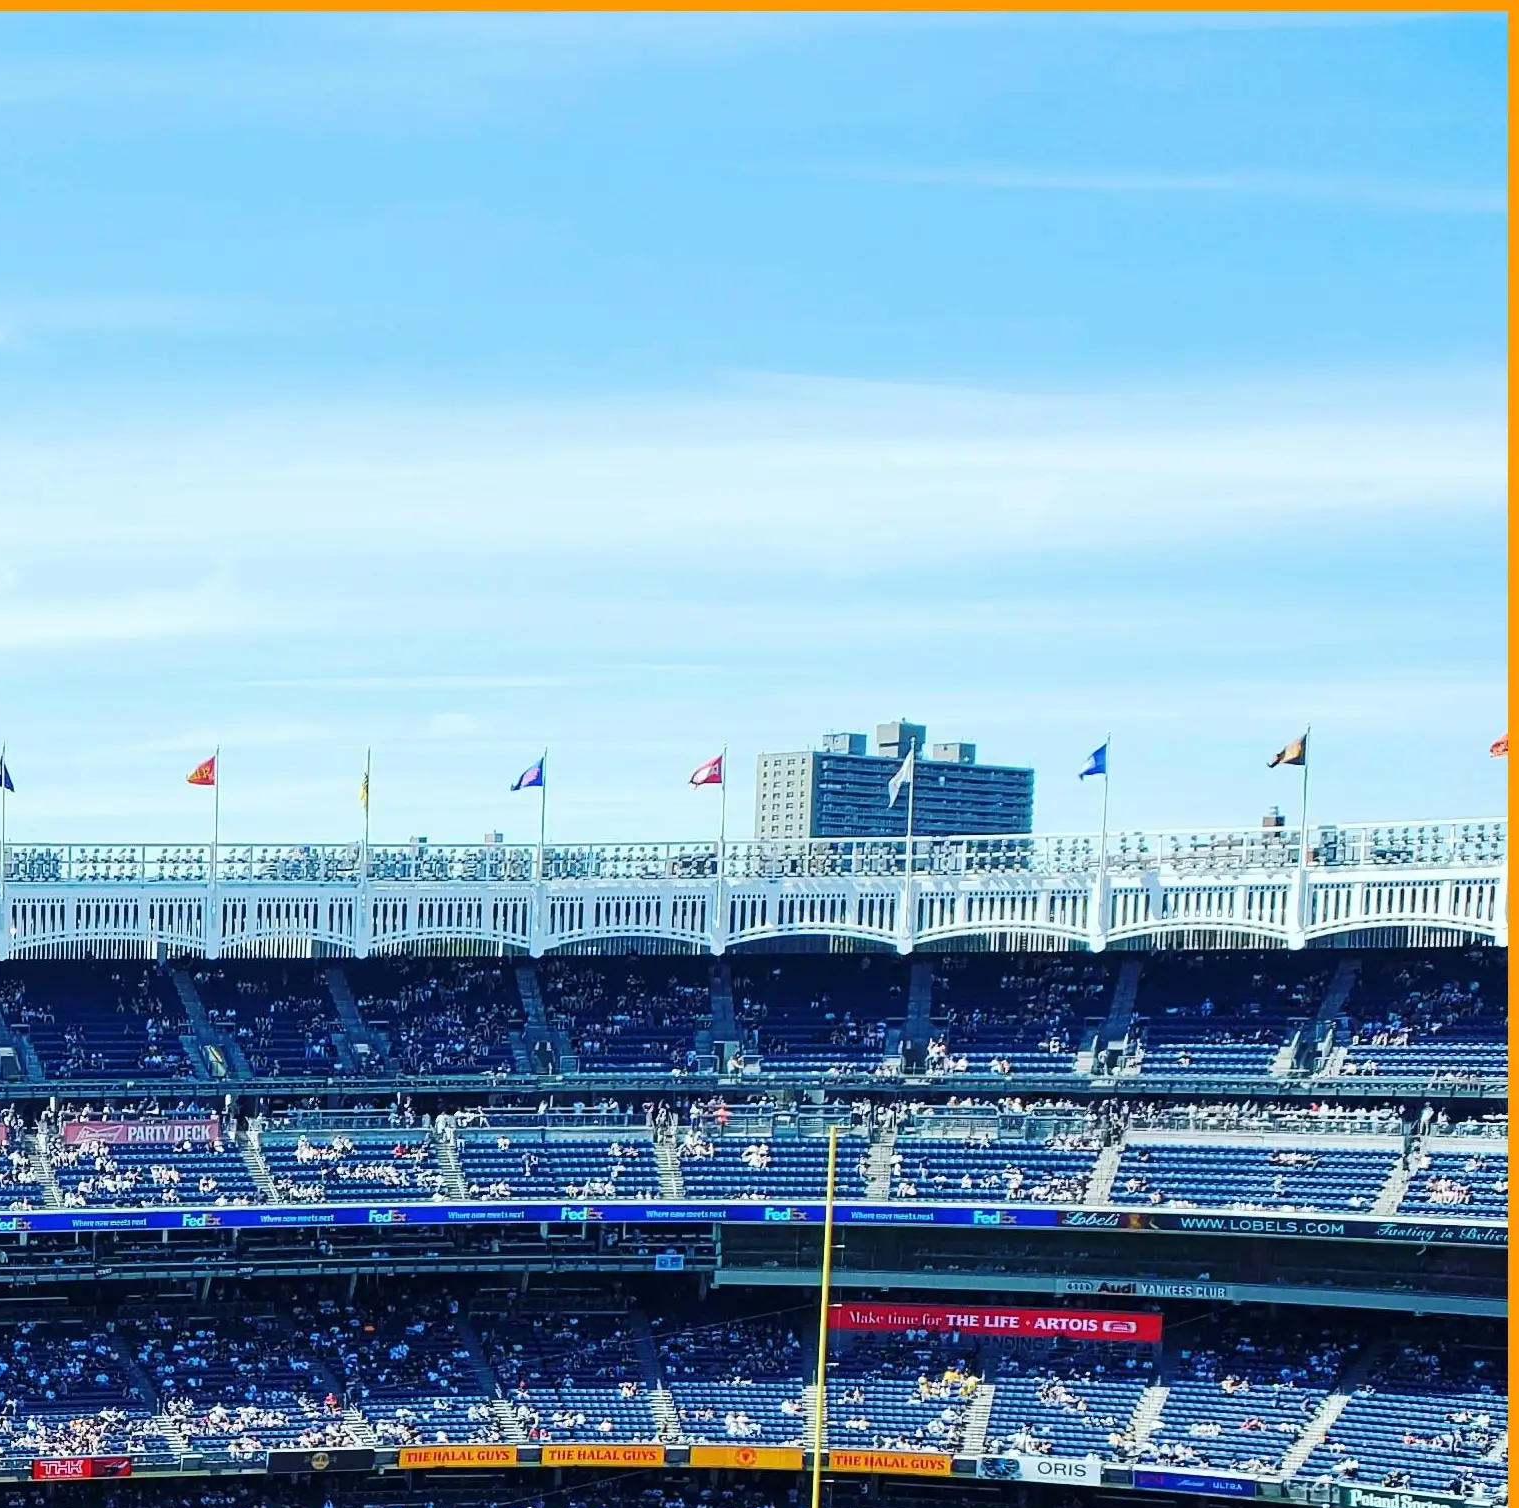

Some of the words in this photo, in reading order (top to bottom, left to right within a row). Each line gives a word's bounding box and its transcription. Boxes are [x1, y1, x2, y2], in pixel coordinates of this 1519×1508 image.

[128, 1126, 171, 1141] PARTY
[173, 1125, 212, 1141] DECK
[183, 1214, 221, 1226] FedEx
[369, 1210, 406, 1222] FedEx
[561, 1207, 603, 1220] FedEx
[765, 1208, 807, 1220] FedEx
[974, 1211, 1017, 1223] FedEx
[1181, 1218, 1344, 1234] WWW.LOBELS.COM
[1376, 1224, 1436, 1239] Tasting
[1440, 1229, 1454, 1238] is
[1098, 1281, 1136, 1293] Audi
[1141, 1284, 1192, 1296] YANKEES
[1196, 1287, 1225, 1297] CLUB
[850, 1311, 883, 1323] Make
[889, 1312, 918, 1324] time
[922, 1314, 942, 1325] for
[946, 1315, 979, 1326] THE
[984, 1316, 1020, 1328] LIFE
[1034, 1318, 1097, 1331] ARTOIS
[406, 1453, 430, 1462] THE
[433, 1451, 474, 1462] HALAL
[477, 1451, 509, 1460] GUYS
[549, 1451, 573, 1460] THE
[577, 1451, 619, 1460] HALAL
[623, 1451, 657, 1460] GUYS
[40, 1460, 83, 1474] THK
[834, 1456, 861, 1466] THE
[865, 1457, 907, 1468] HALAL
[911, 1460, 944, 1470] GUYS
[1038, 1462, 1086, 1477] ORIS
[1349, 1489, 1399, 1508] Poland
